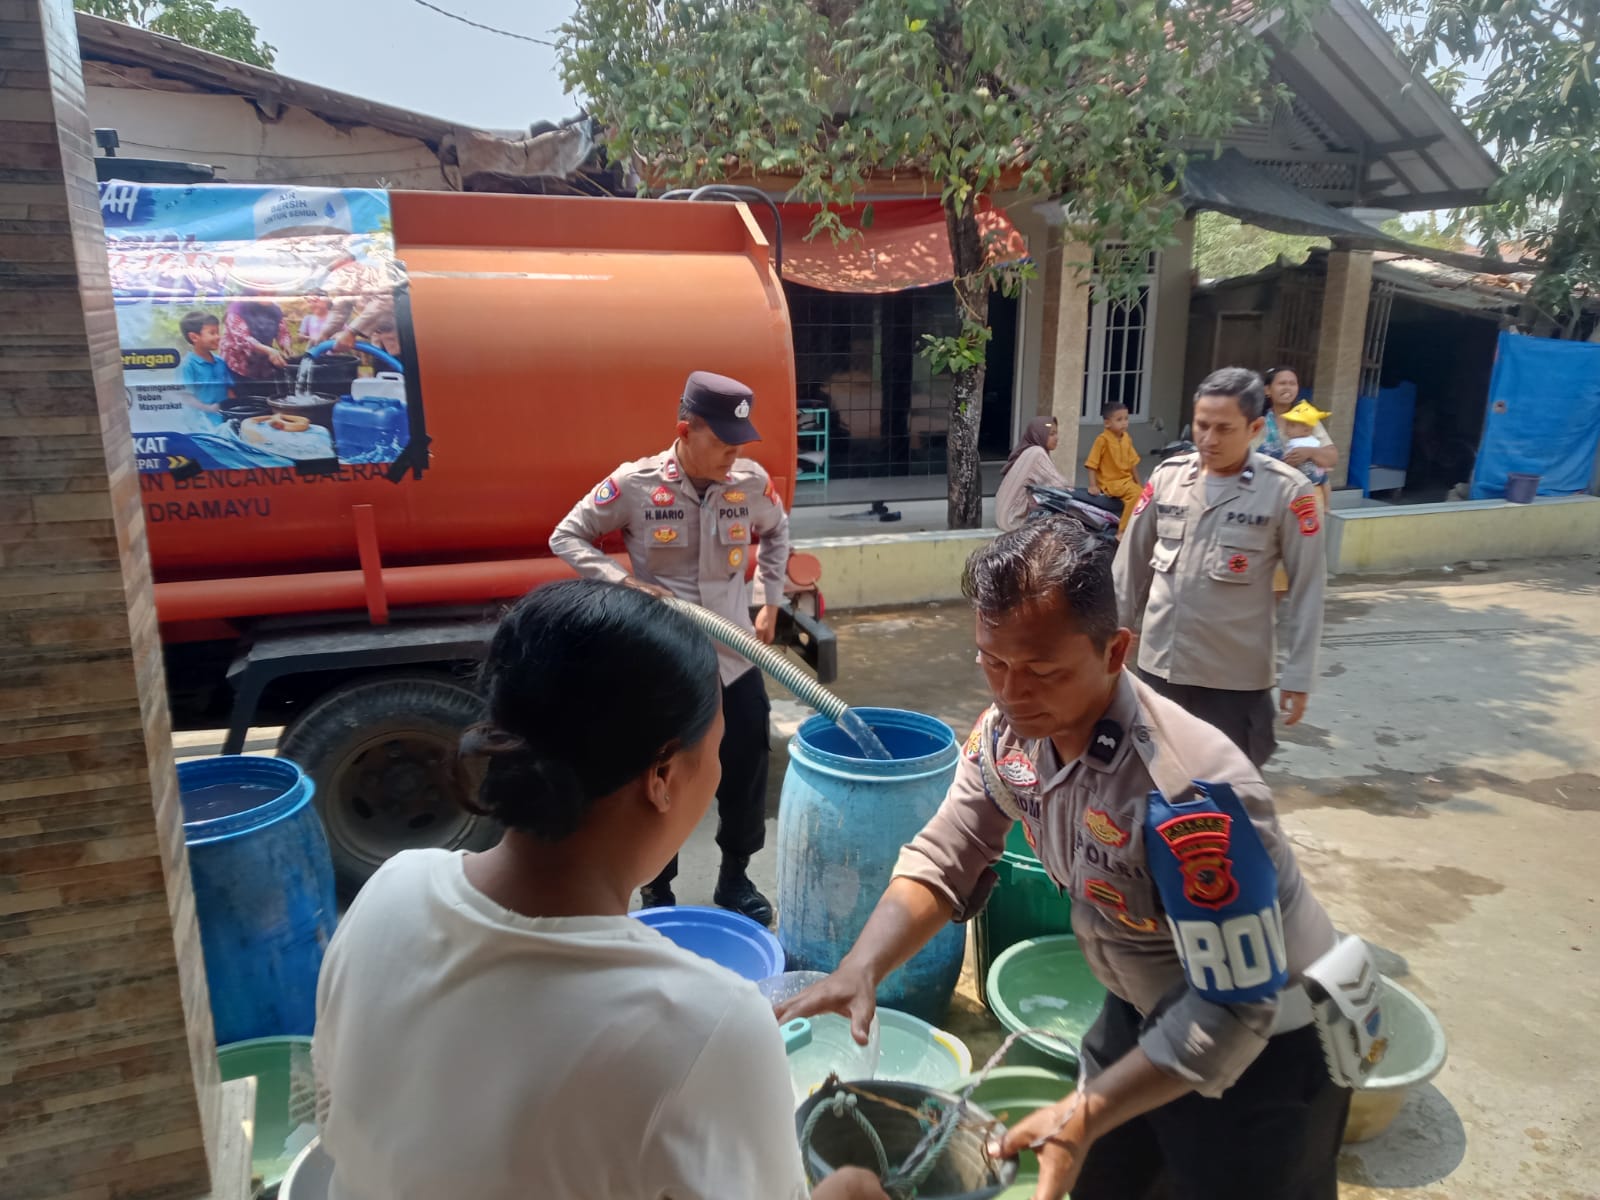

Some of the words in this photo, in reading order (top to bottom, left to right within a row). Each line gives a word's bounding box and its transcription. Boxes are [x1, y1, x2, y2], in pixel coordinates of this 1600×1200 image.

[97, 184, 140, 221] AH
[137, 393, 163, 402] Beban
[139, 402, 183, 412] Masyarakat
[719, 506, 749, 519] POLRI
[1076, 830, 1145, 880] POLRI
